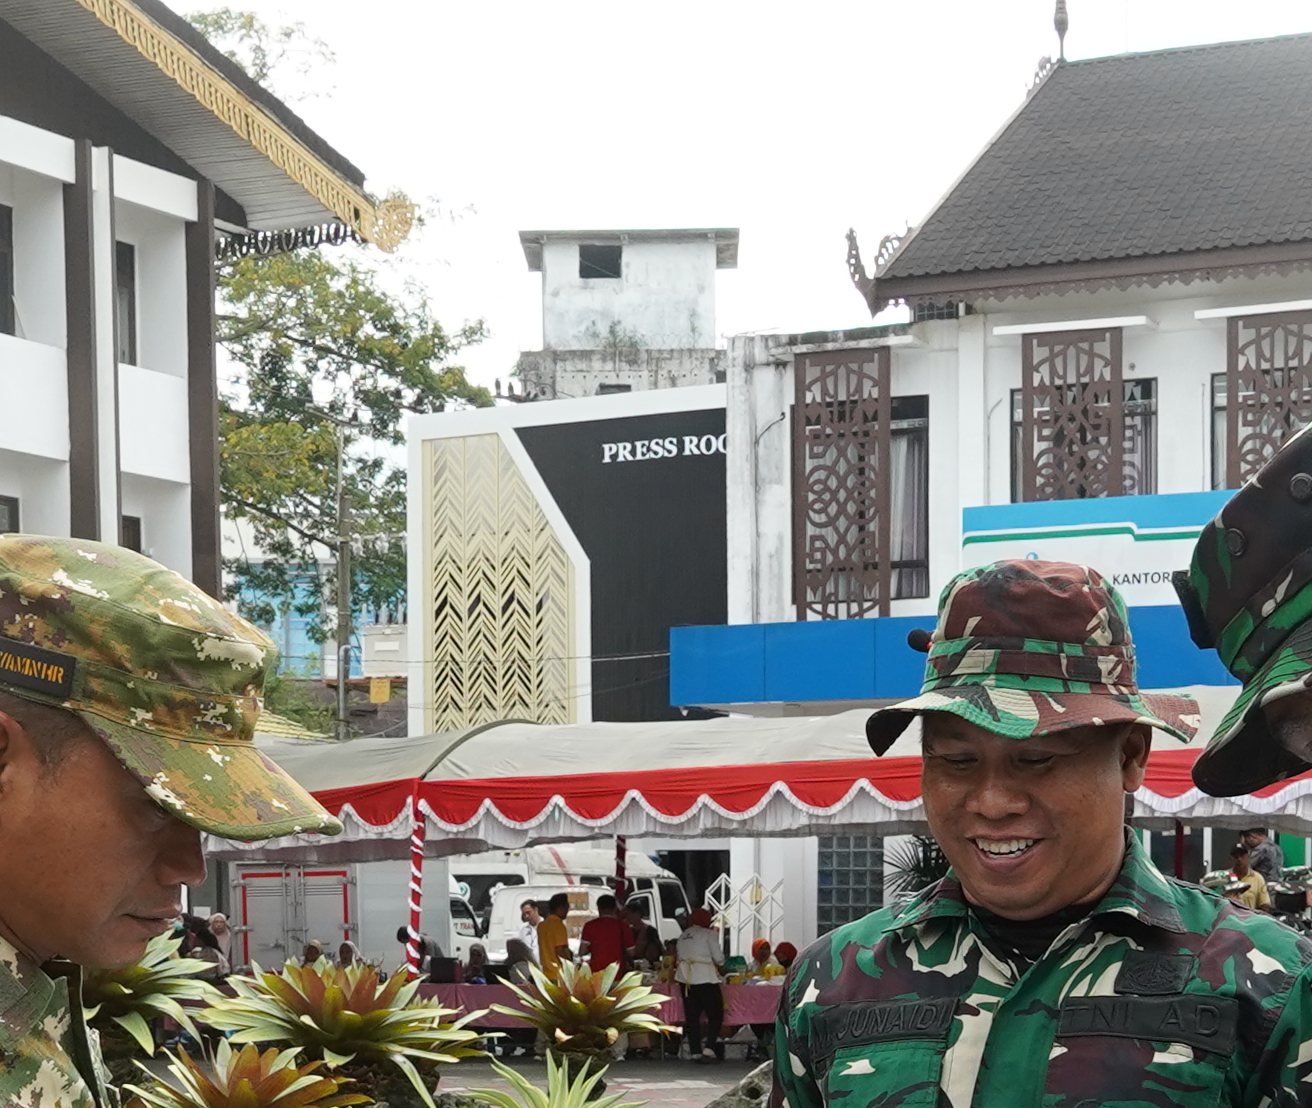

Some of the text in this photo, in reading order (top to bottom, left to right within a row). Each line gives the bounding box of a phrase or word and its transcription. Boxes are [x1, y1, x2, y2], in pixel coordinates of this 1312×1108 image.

[602, 437, 678, 464] PRESS
[1112, 571, 1170, 586] KANTOR
[1064, 1001, 1130, 1029] TNI
